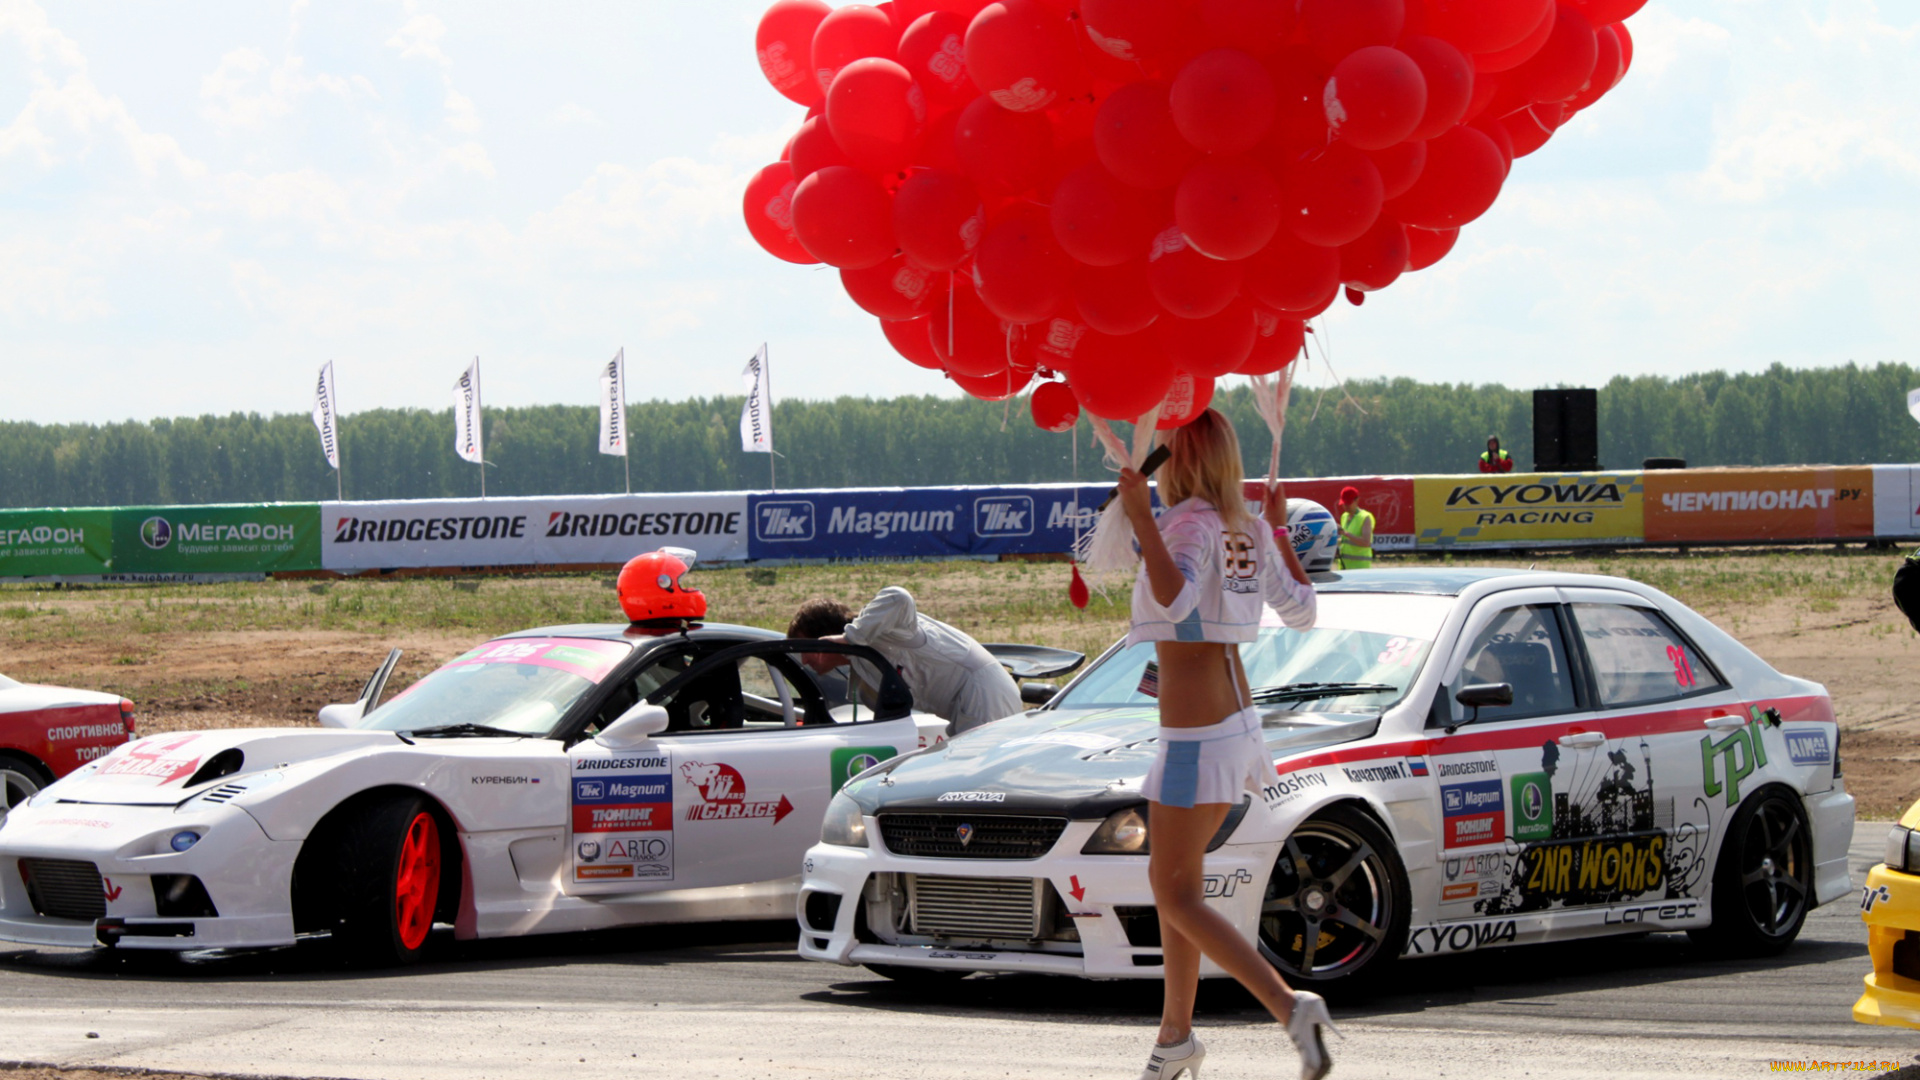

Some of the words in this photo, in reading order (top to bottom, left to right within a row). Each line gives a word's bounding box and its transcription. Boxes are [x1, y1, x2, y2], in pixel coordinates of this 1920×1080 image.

[1445, 484, 1622, 506] KYOWA
[546, 511, 741, 537] BRIDGESTONE
[828, 506, 955, 538] Magnum
[1476, 512, 1594, 525] RACING
[0, 526, 84, 545] ЕГАФОН
[334, 515, 526, 543] BRIDGESTONE
[1666, 645, 1696, 687] 31
[48, 723, 124, 741] СПОРТИВНОЕ
[576, 757, 668, 770] BRIDGESTONE
[1439, 760, 1497, 777] BRIDGESTONE
[472, 776, 528, 785] КУРЕНБИН
[609, 784, 665, 798] Magnum
[1465, 791, 1500, 807] Magnum
[701, 802, 779, 819] GARAGE
[1527, 844, 1572, 895] 2NR
[1578, 834, 1663, 893] WORKS
[1407, 920, 1517, 954] KYOWA
